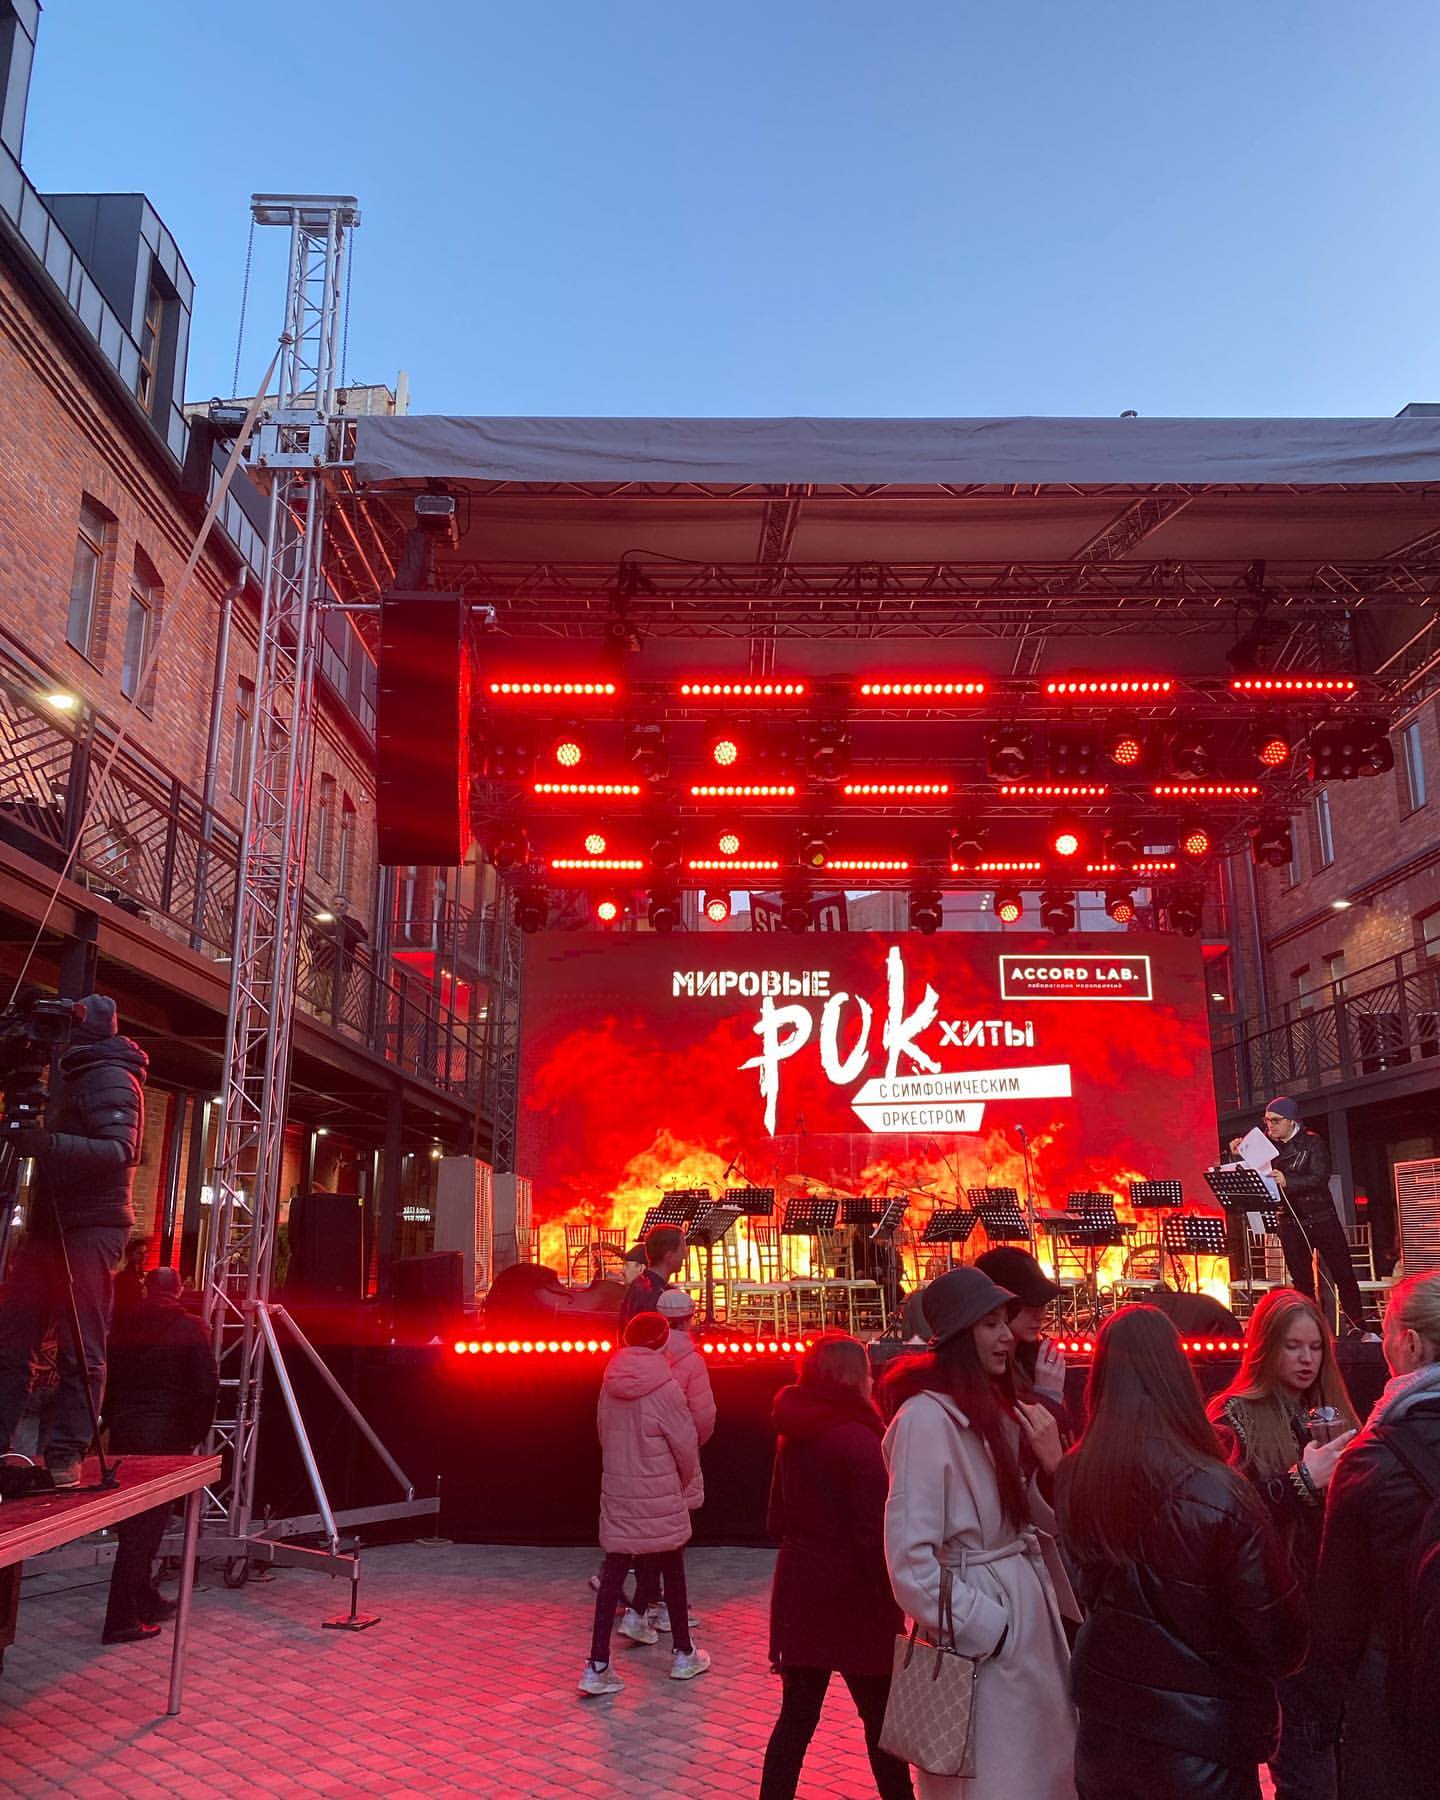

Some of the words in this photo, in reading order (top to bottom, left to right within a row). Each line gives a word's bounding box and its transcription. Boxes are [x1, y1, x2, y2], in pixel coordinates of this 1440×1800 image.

[672, 970, 831, 997] МИРОВЫЕ
[1011, 967, 1088, 981] ACCORD
[1095, 967, 1139, 981] LAB.
[737, 946, 942, 1137] РОК
[938, 1020, 1034, 1047] ХИТЫ
[879, 1083, 887, 1098] С
[891, 1077, 1020, 1098] СИМФОНИЧЕСКИМ
[882, 1109, 966, 1126] ОРКЕСТРОМ
